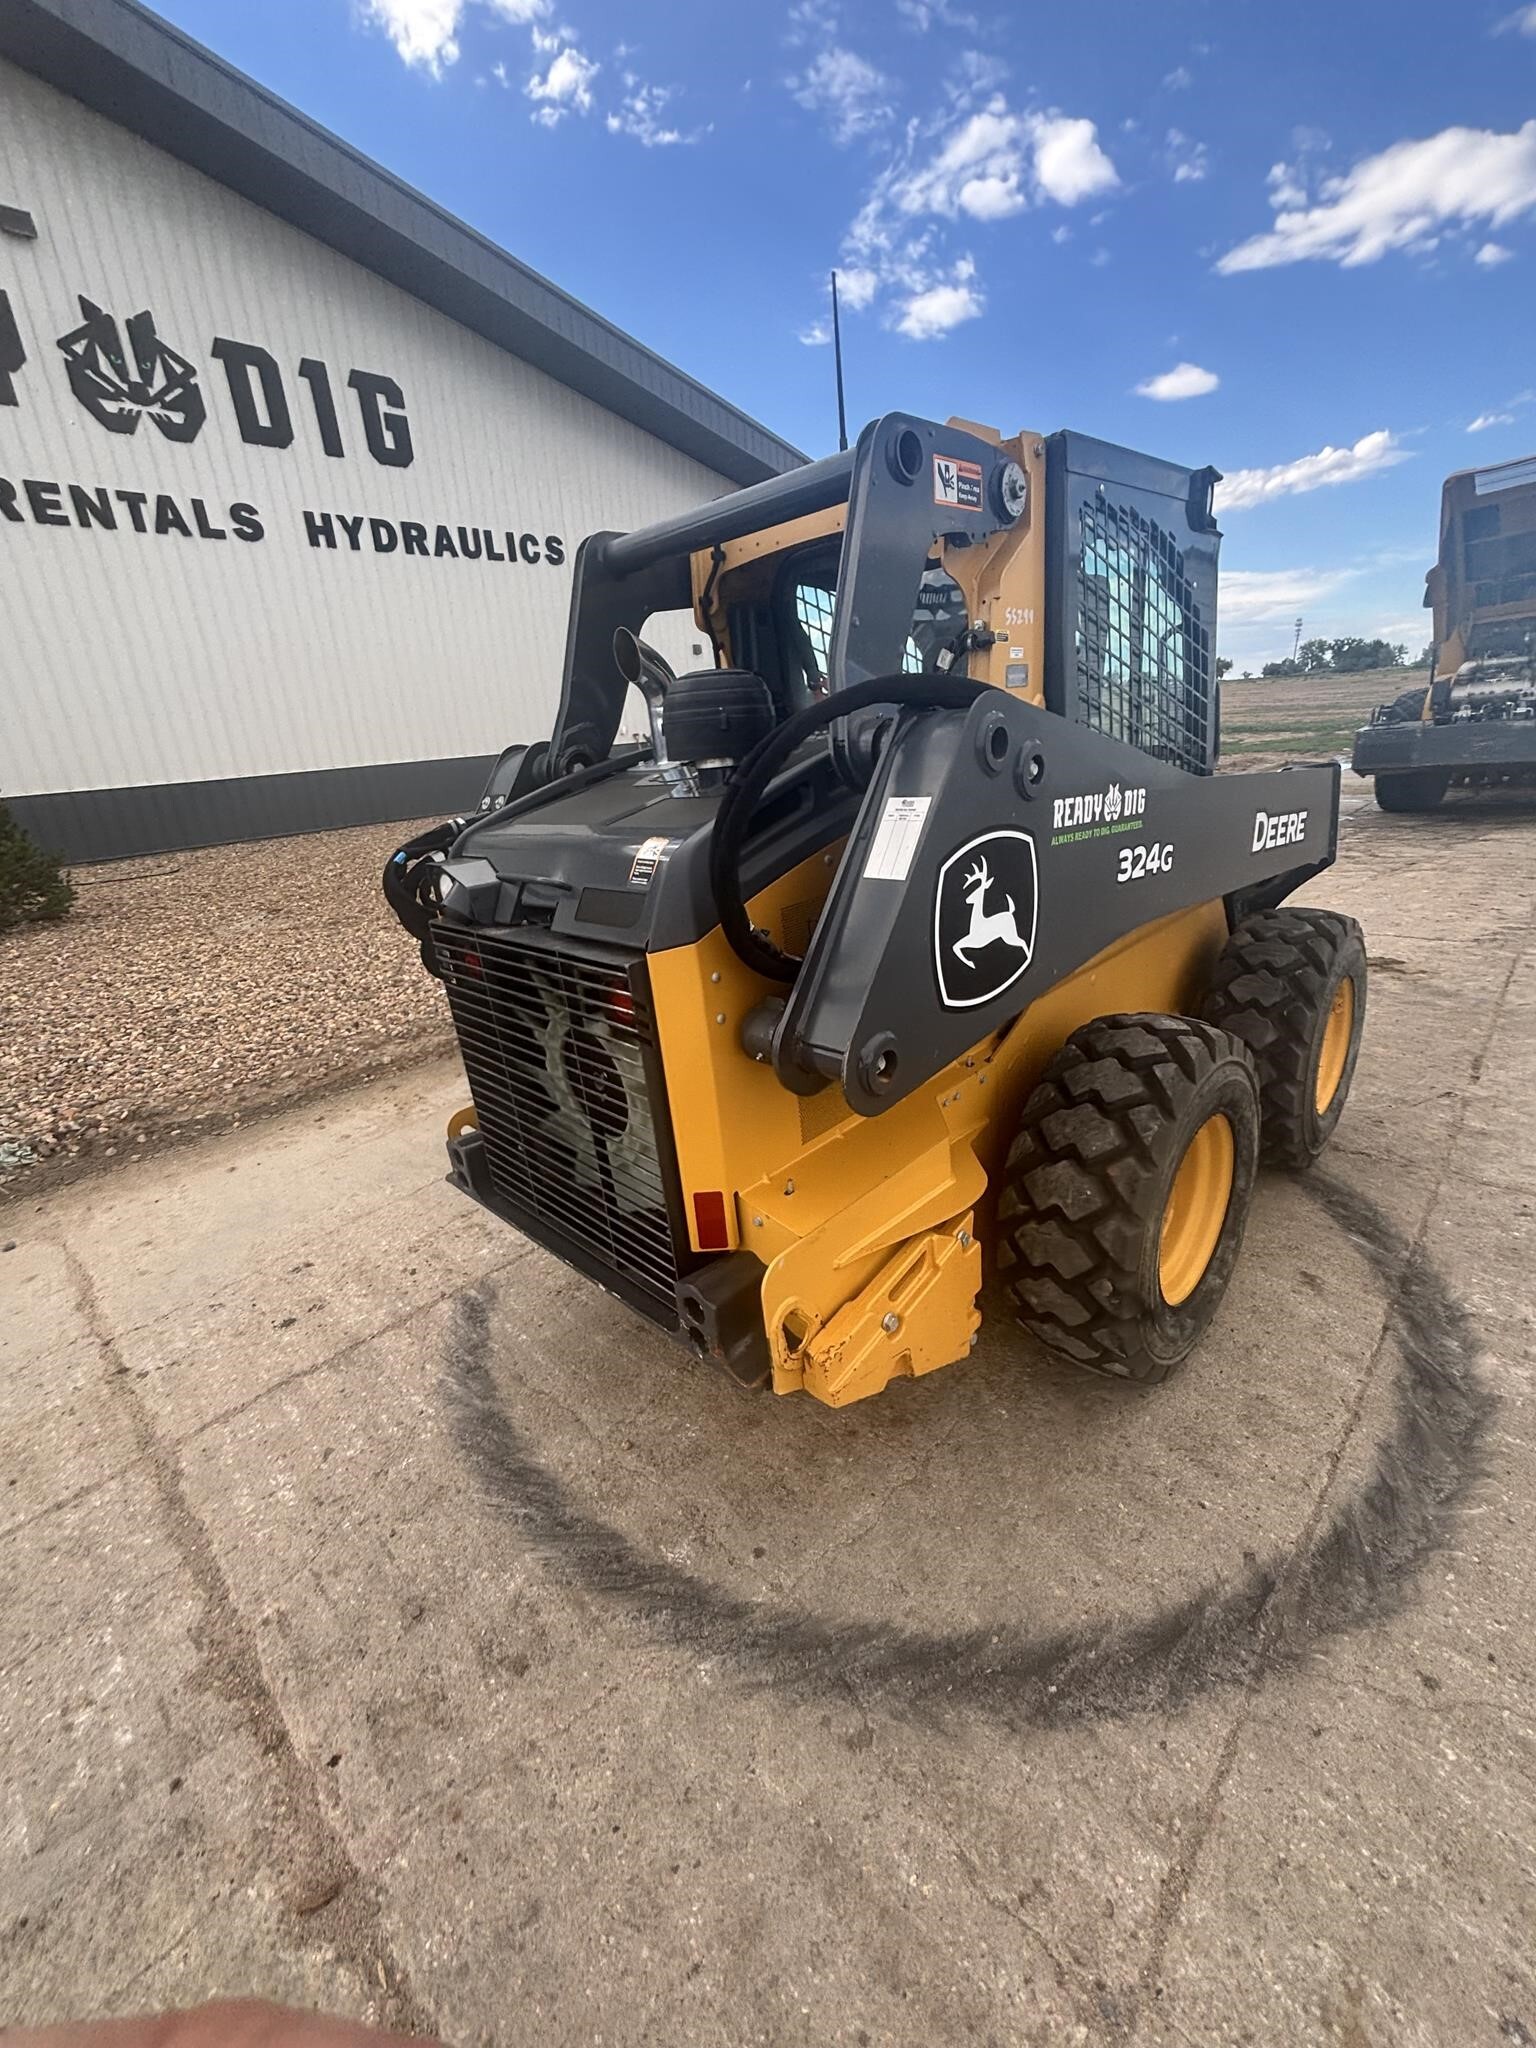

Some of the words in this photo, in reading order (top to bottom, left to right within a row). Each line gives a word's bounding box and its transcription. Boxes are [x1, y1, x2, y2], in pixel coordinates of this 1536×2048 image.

[211, 337, 414, 468] DIG
[303, 511, 565, 566] HYDRAULICS
[1053, 794, 1103, 829] READY
[1124, 788, 1146, 817] DIG
[1050, 833, 1074, 846] ALWAYS
[1252, 811, 1308, 853] DEERE
[1117, 843, 1174, 882] 324G
